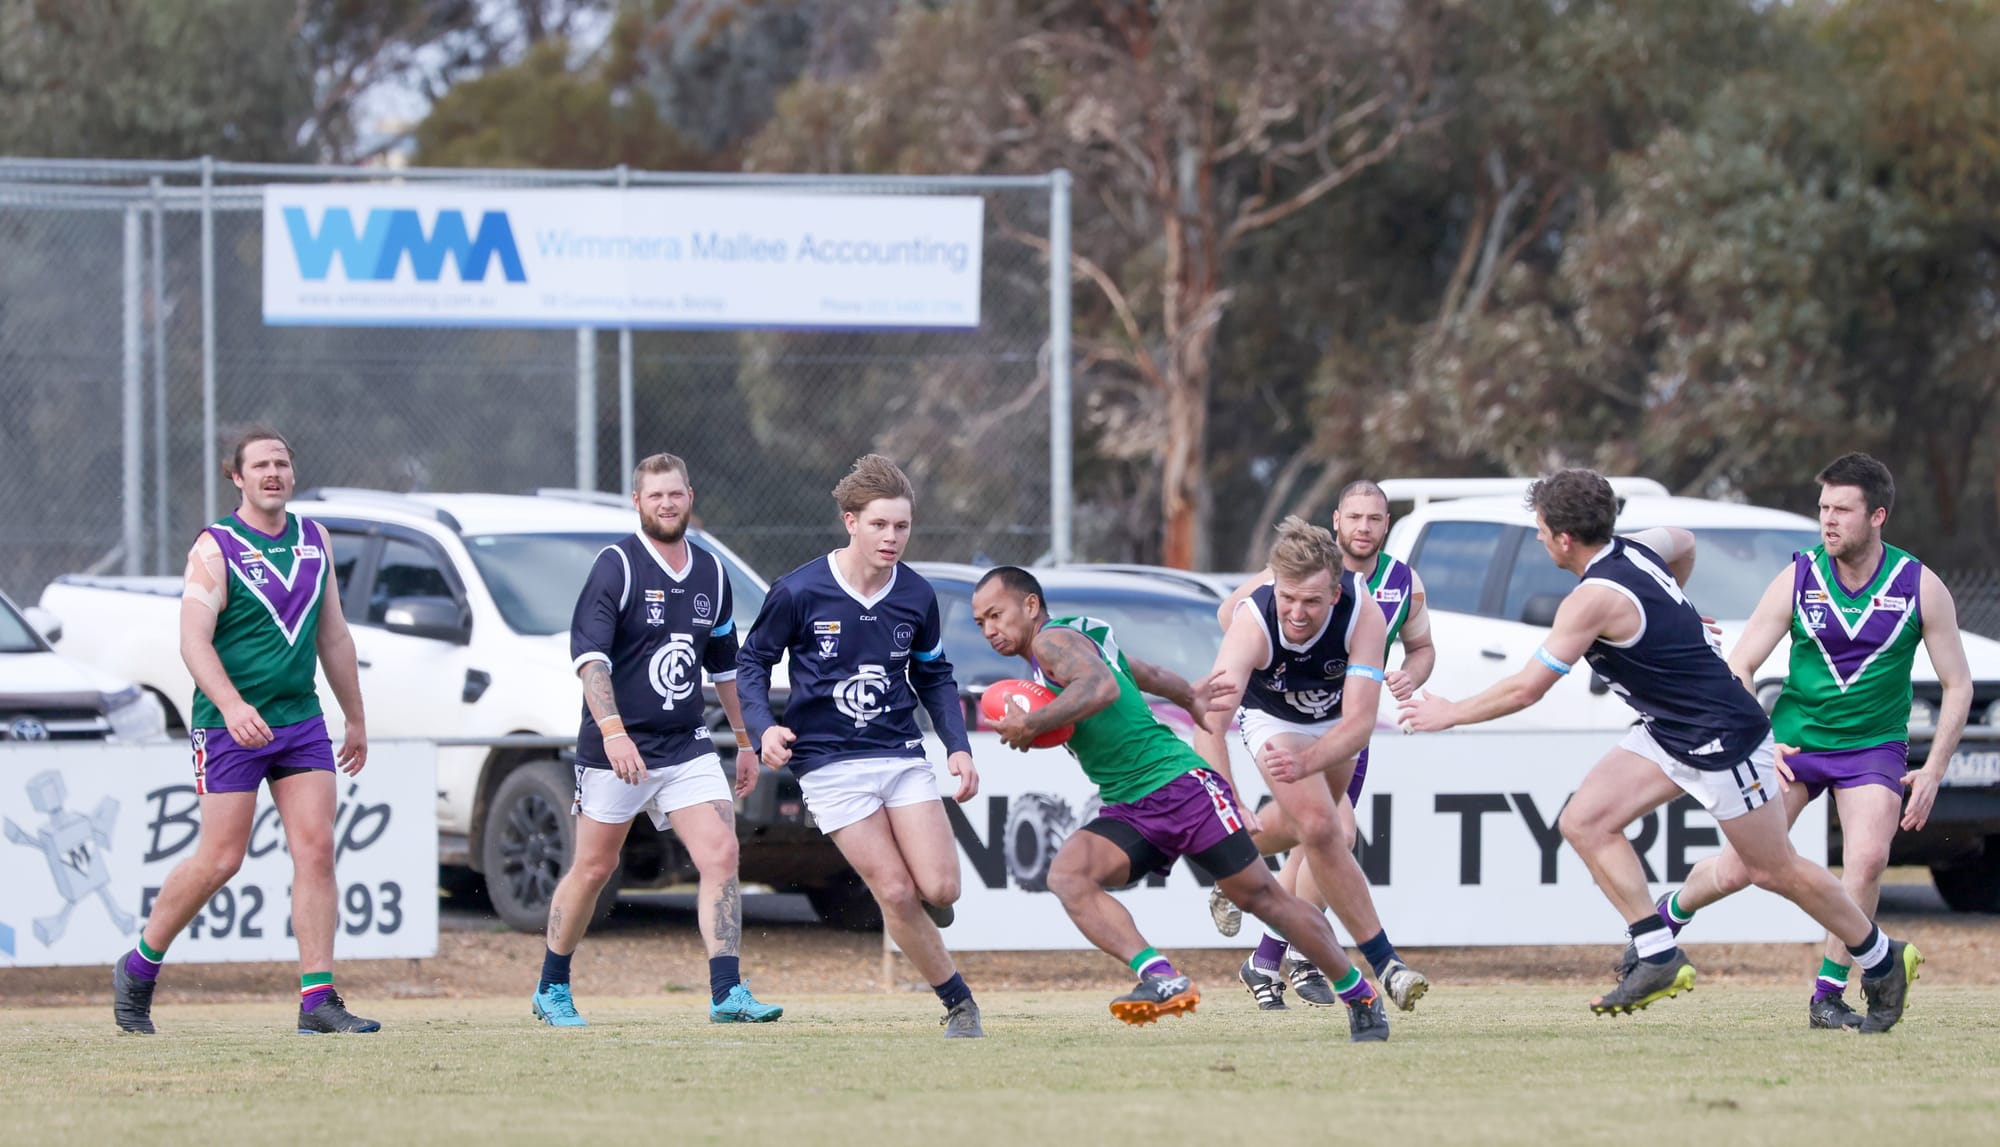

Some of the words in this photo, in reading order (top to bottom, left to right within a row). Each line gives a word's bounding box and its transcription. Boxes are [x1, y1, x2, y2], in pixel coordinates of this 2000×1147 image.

[281, 206, 528, 283] WMA
[536, 228, 682, 261] Wimmera
[692, 230, 787, 263] Mallee
[798, 232, 969, 272] Accounting
